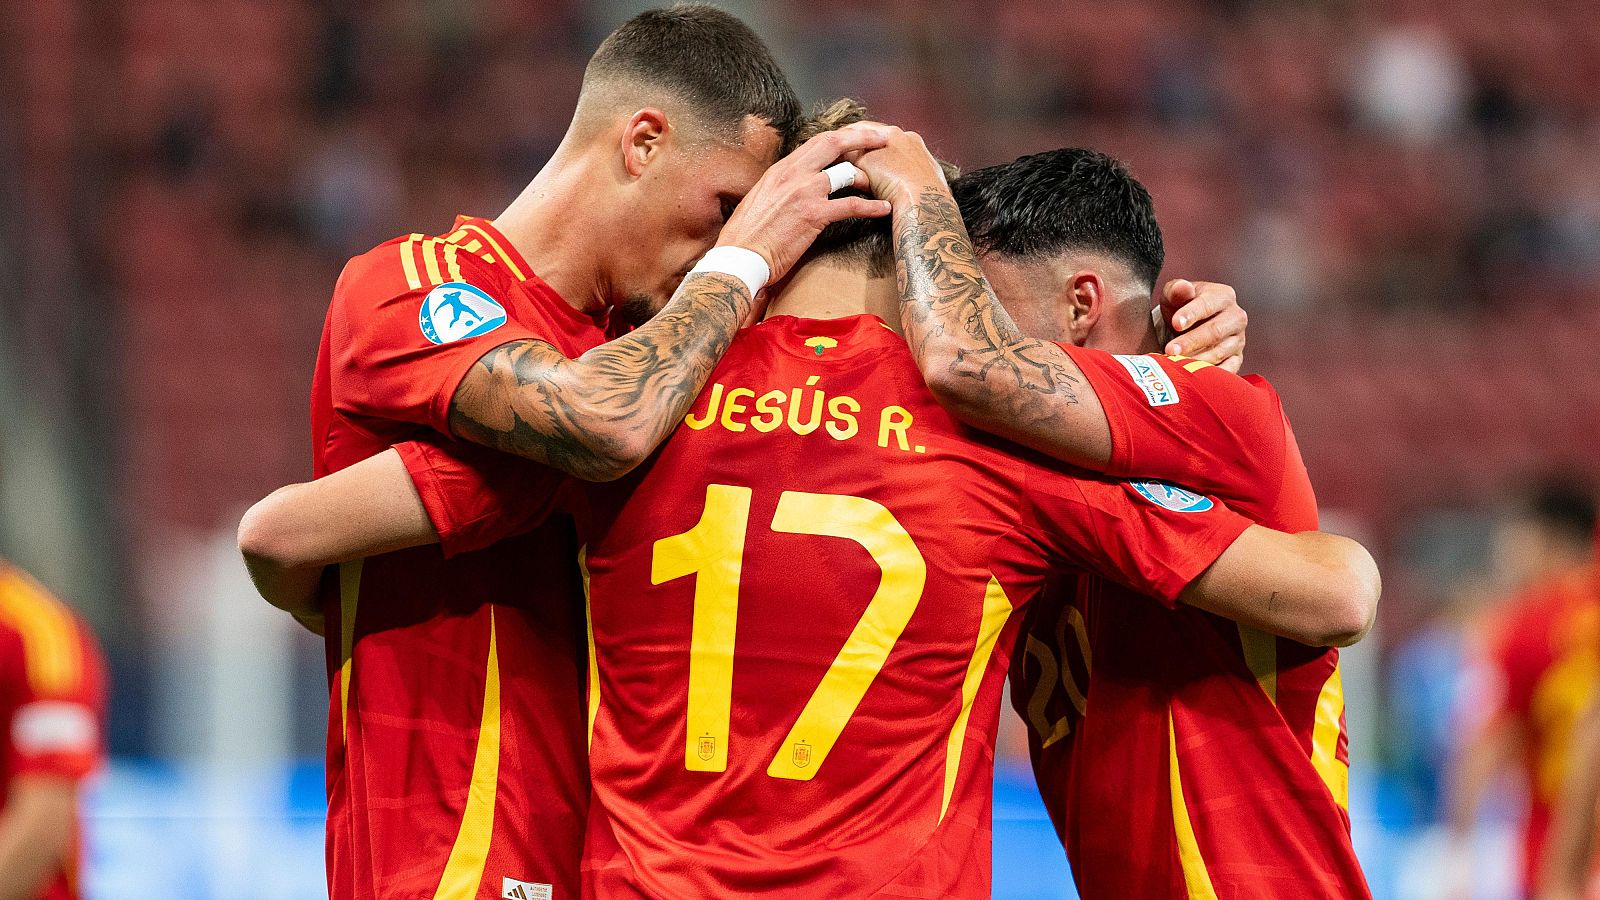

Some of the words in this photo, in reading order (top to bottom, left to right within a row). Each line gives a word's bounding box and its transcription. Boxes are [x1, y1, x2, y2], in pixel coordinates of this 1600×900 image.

[684, 375, 861, 441] JESÚS
[877, 405, 926, 453] R.
[651, 483, 927, 781] 17
[1022, 605, 1093, 749] 20
